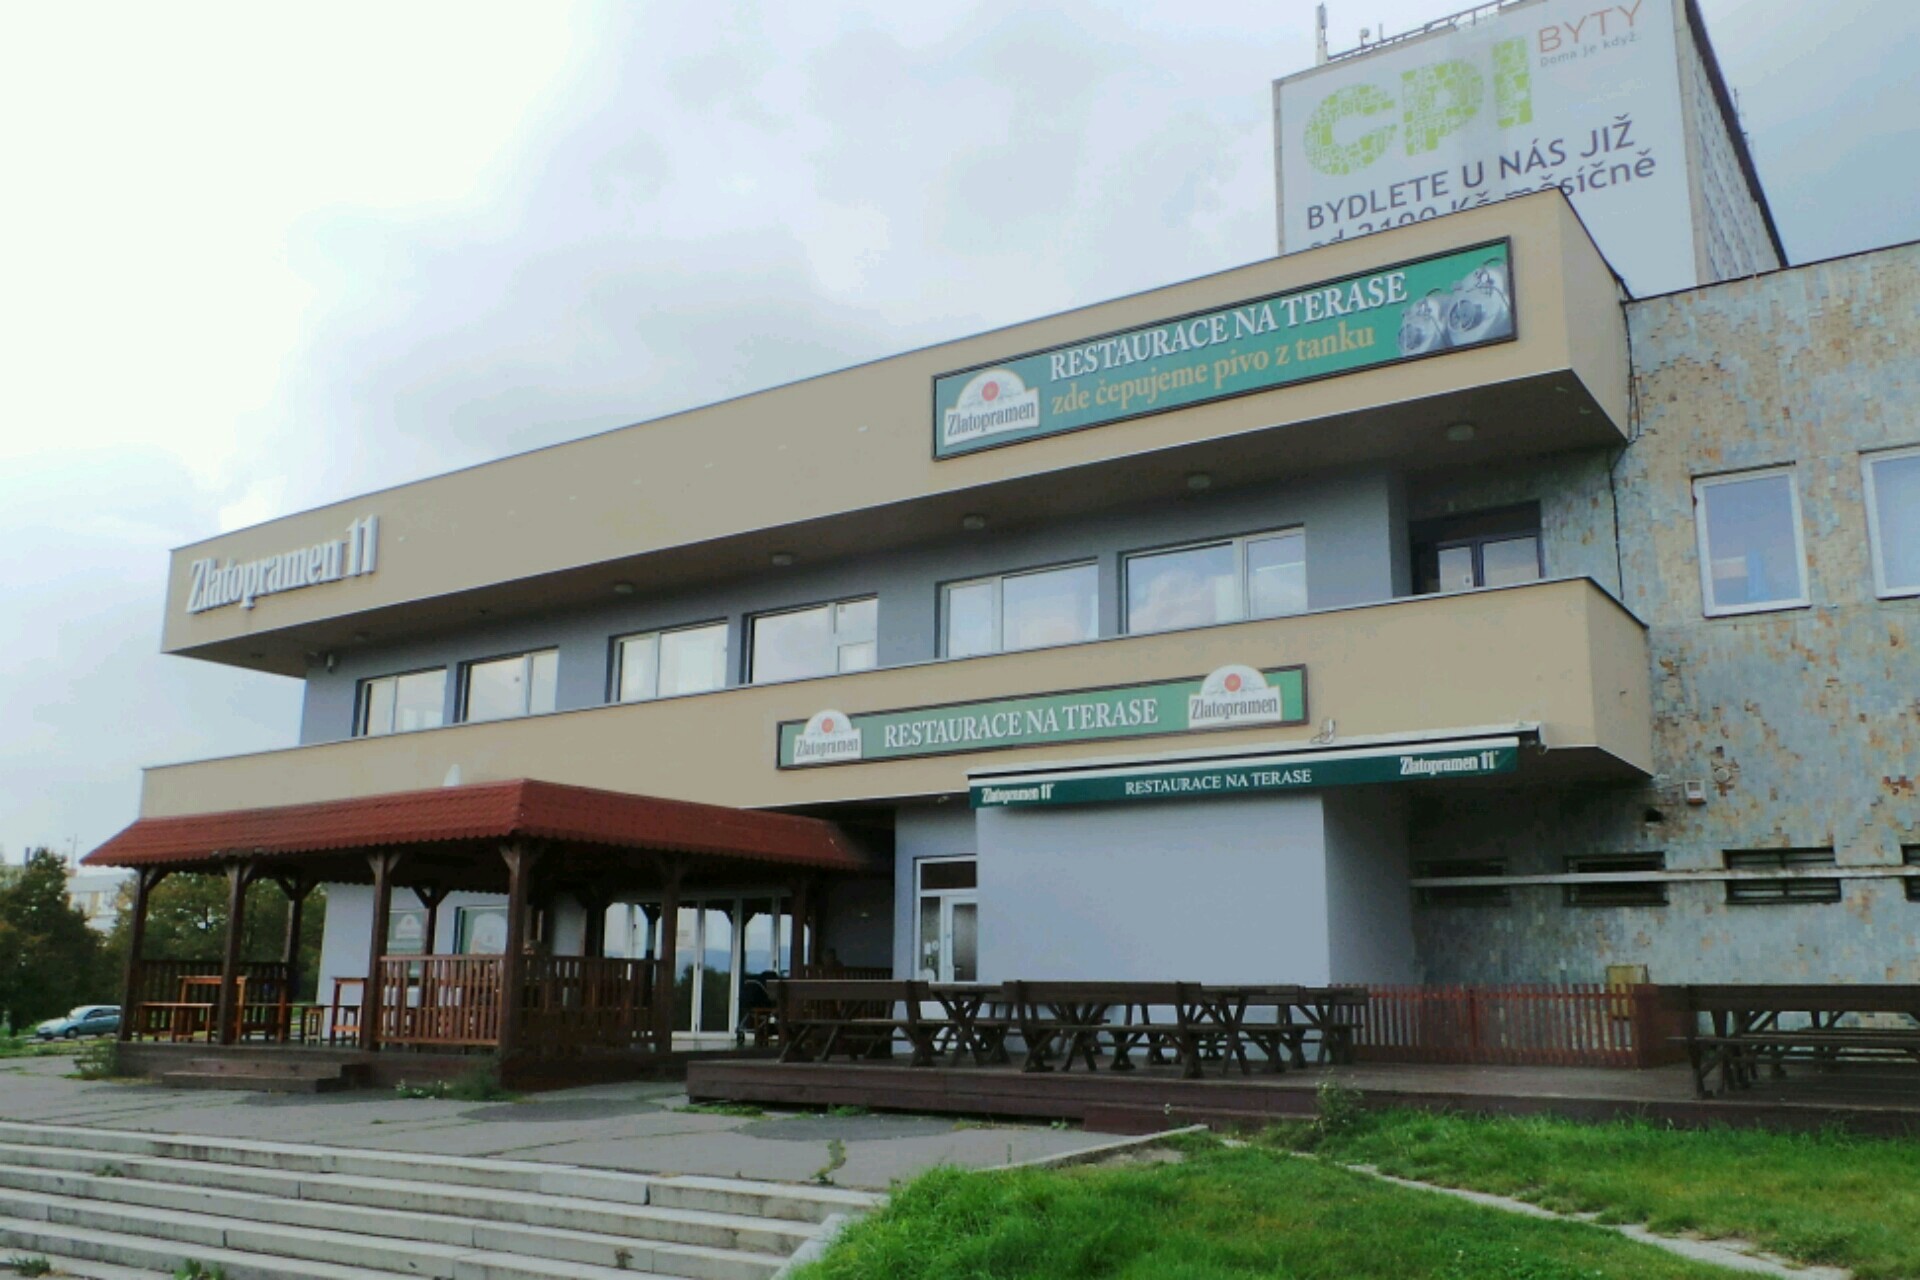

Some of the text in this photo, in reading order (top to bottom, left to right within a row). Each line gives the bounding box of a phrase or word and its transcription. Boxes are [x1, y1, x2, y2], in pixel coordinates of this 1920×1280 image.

[1539, 0, 1643, 54] BYTY
[1304, 37, 1533, 177] CPI
[1307, 170, 1449, 230] BYDLETE
[1462, 161, 1484, 188] U
[1499, 138, 1567, 180] NÁS
[1580, 113, 1636, 158] JIŽ
[1050, 271, 1408, 381] RESTAURACE NA TERASE
[1052, 320, 1375, 414] zde čepujeme pivo z tanku
[946, 401, 1036, 437] Zlatopramen
[186, 513, 379, 614] Zlatopramen 11
[884, 698, 1159, 748] RESTAURACE NA TERASE
[1190, 697, 1278, 721] Zlatopramen
[795, 736, 859, 758] Zlatopramen
[1400, 755, 1479, 775] Zlatopramen
[981, 787, 1040, 804] Zlatopramen
[1125, 769, 1312, 796] RESTAURACE NA TERASE
